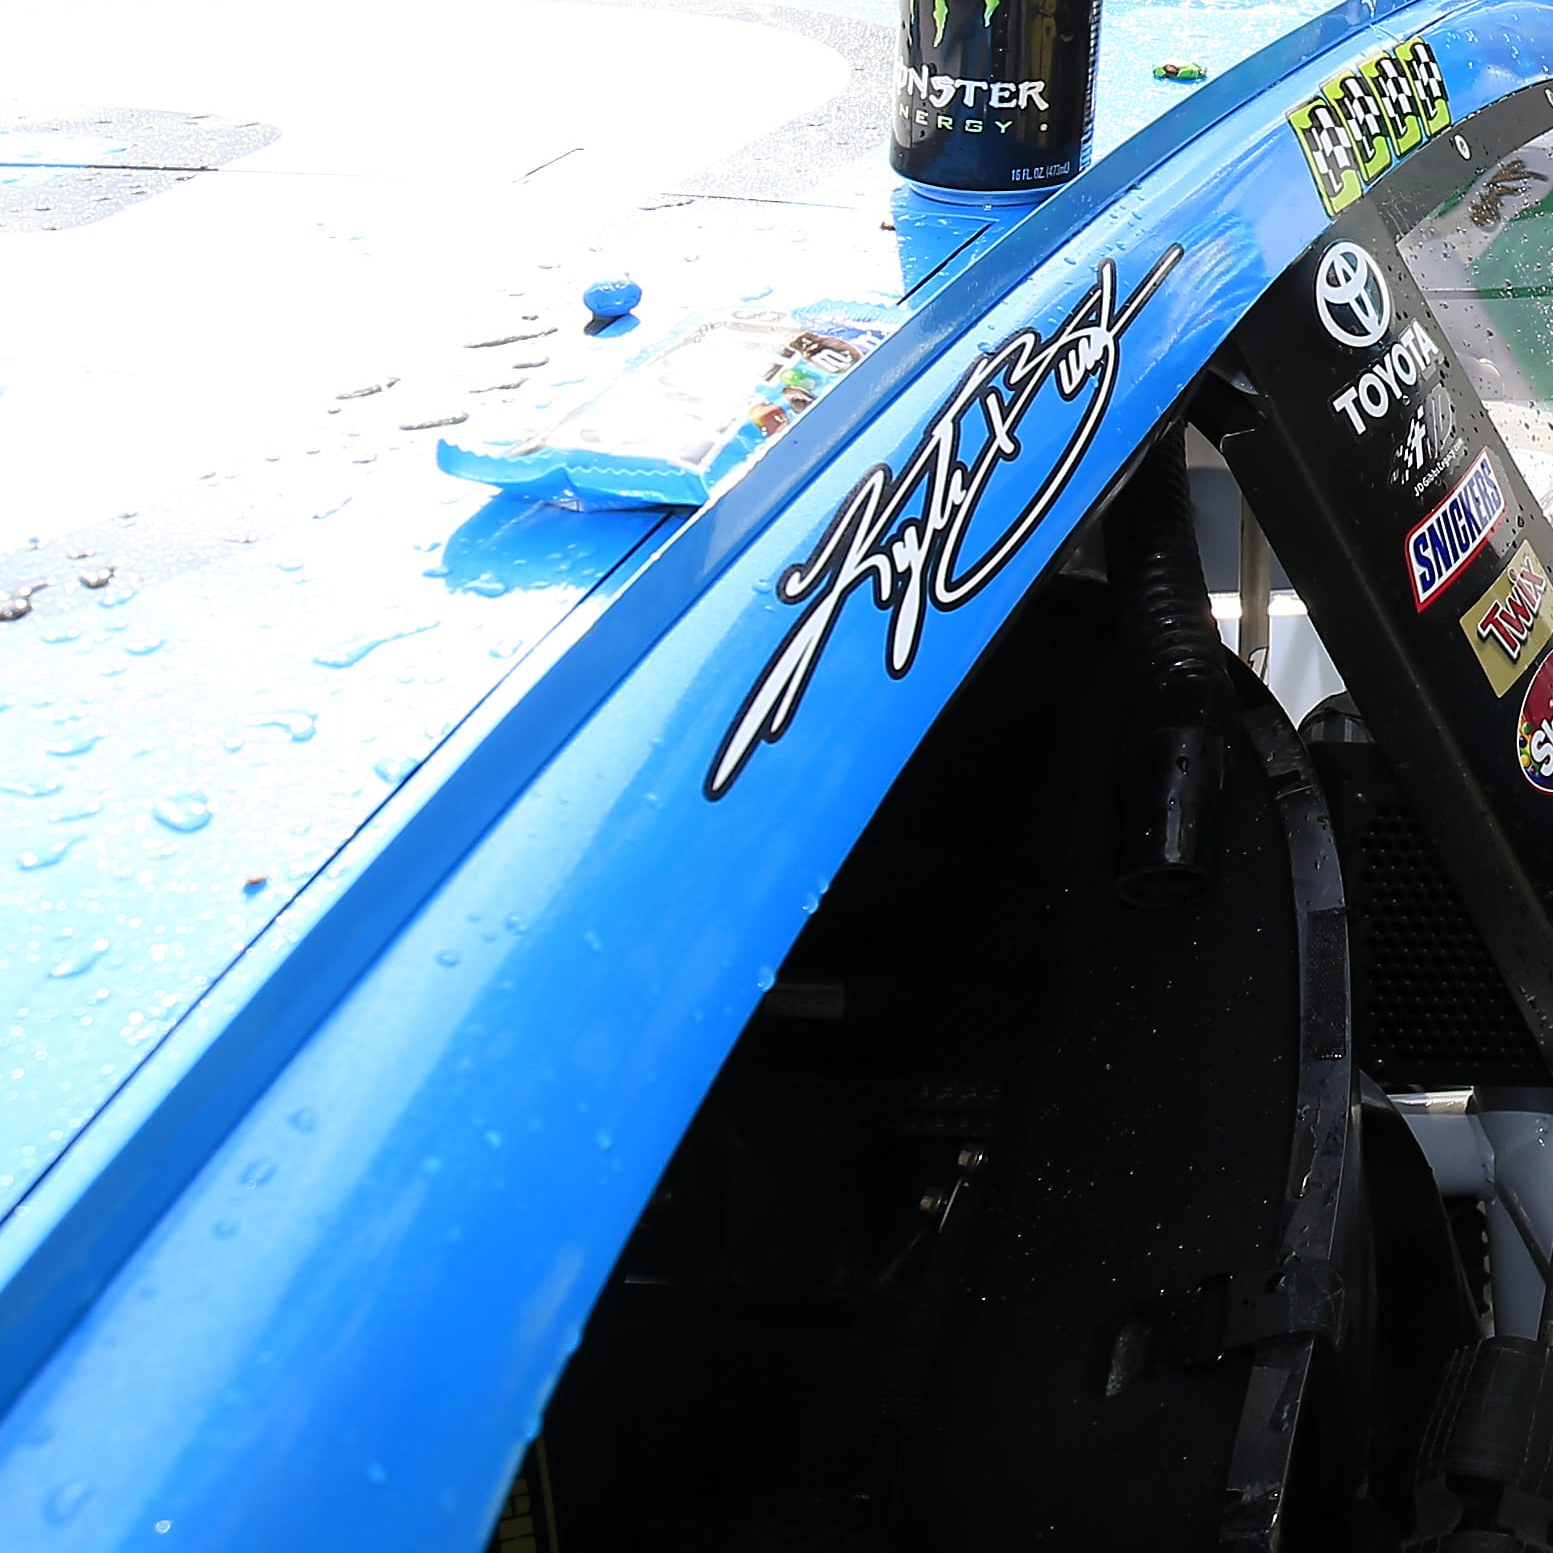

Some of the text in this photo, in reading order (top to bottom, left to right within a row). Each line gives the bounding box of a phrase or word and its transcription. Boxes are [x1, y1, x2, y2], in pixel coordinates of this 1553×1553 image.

[898, 55, 1050, 111] ONSTER
[899, 102, 1013, 134] NERGY
[1332, 320, 1440, 435] TOYOTA
[1413, 458, 1502, 594] SNICKERS
